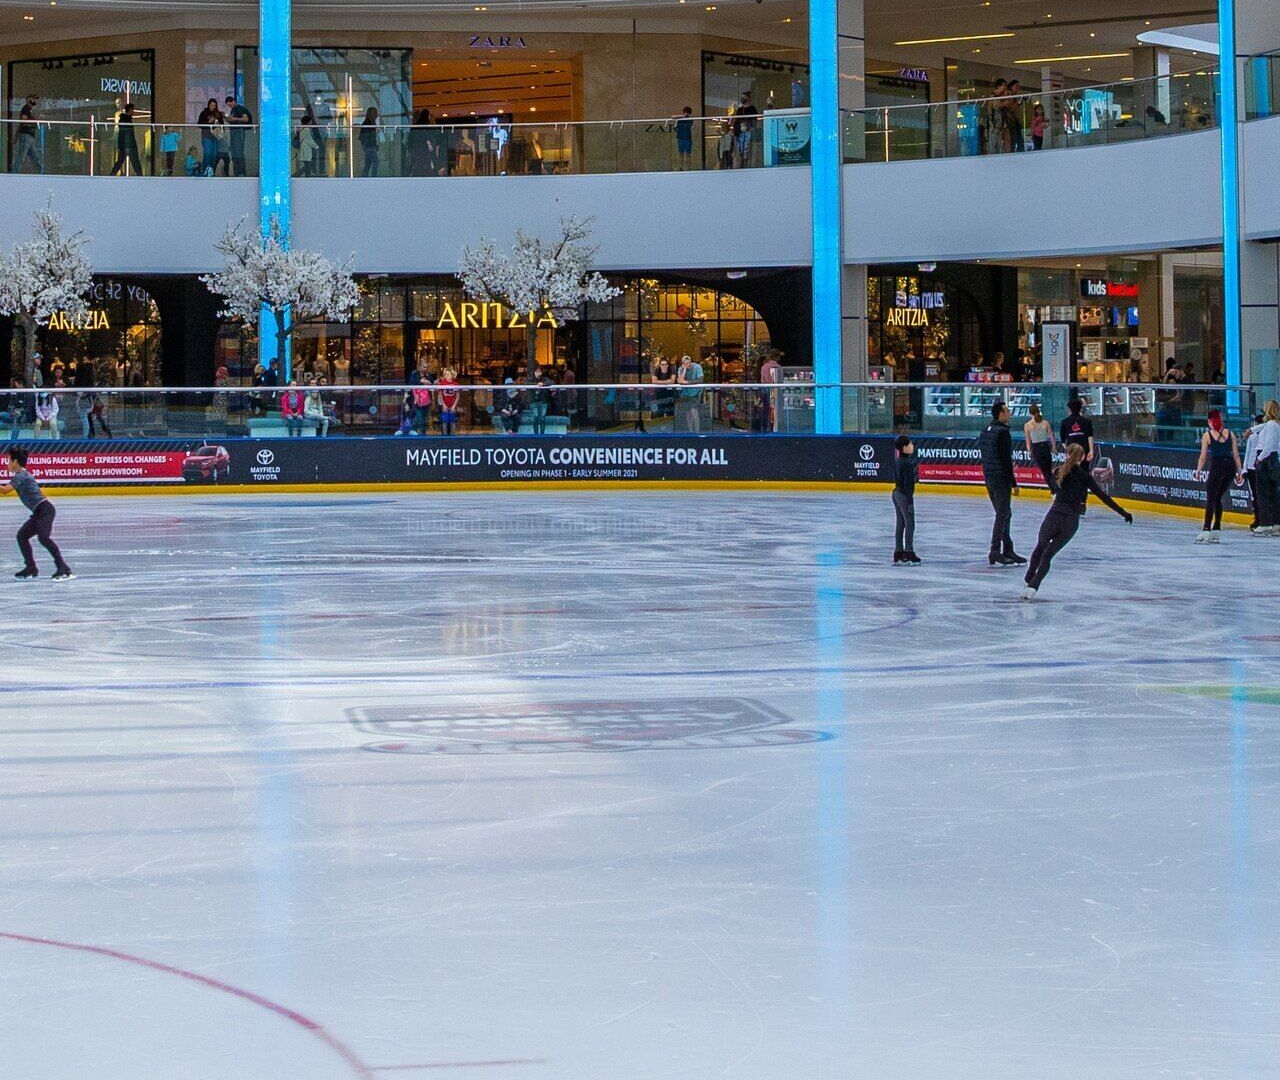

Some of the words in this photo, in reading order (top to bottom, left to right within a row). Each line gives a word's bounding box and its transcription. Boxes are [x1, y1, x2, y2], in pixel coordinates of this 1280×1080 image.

[468, 35, 528, 49] ZARA
[899, 67, 928, 82] ZARA
[1088, 280, 1107, 295] kids
[886, 307, 929, 327] ARITZIA
[406, 448, 481, 466] MAYFIELD
[485, 448, 546, 465] TOYOTA
[549, 448, 663, 465] CONVENIENCE
[666, 448, 697, 465] FOR
[700, 448, 728, 465] ALL
[917, 448, 958, 458] MAYFIELD
[52, 456, 87, 465] PACKAGES
[94, 456, 122, 464] EXPRESS
[123, 456, 134, 464] OIL
[134, 455, 167, 464] CHANGES
[854, 461, 880, 469] MAYFIELD
[32, 469, 44, 477] 30+
[44, 468, 72, 477] VEHICLE
[72, 467, 101, 476] MASSIVE
[101, 467, 143, 476] SHOWROOM
[250, 466, 281, 474] MAYFIELD
[501, 470, 532, 478] OPENING
[533, 470, 539, 478] IN
[541, 470, 562, 478] PHASE
[573, 469, 592, 478] EARLY
[593, 469, 622, 478] SUMMER
[623, 470, 638, 478] 2021
[856, 469, 878, 477] TOYOTA
